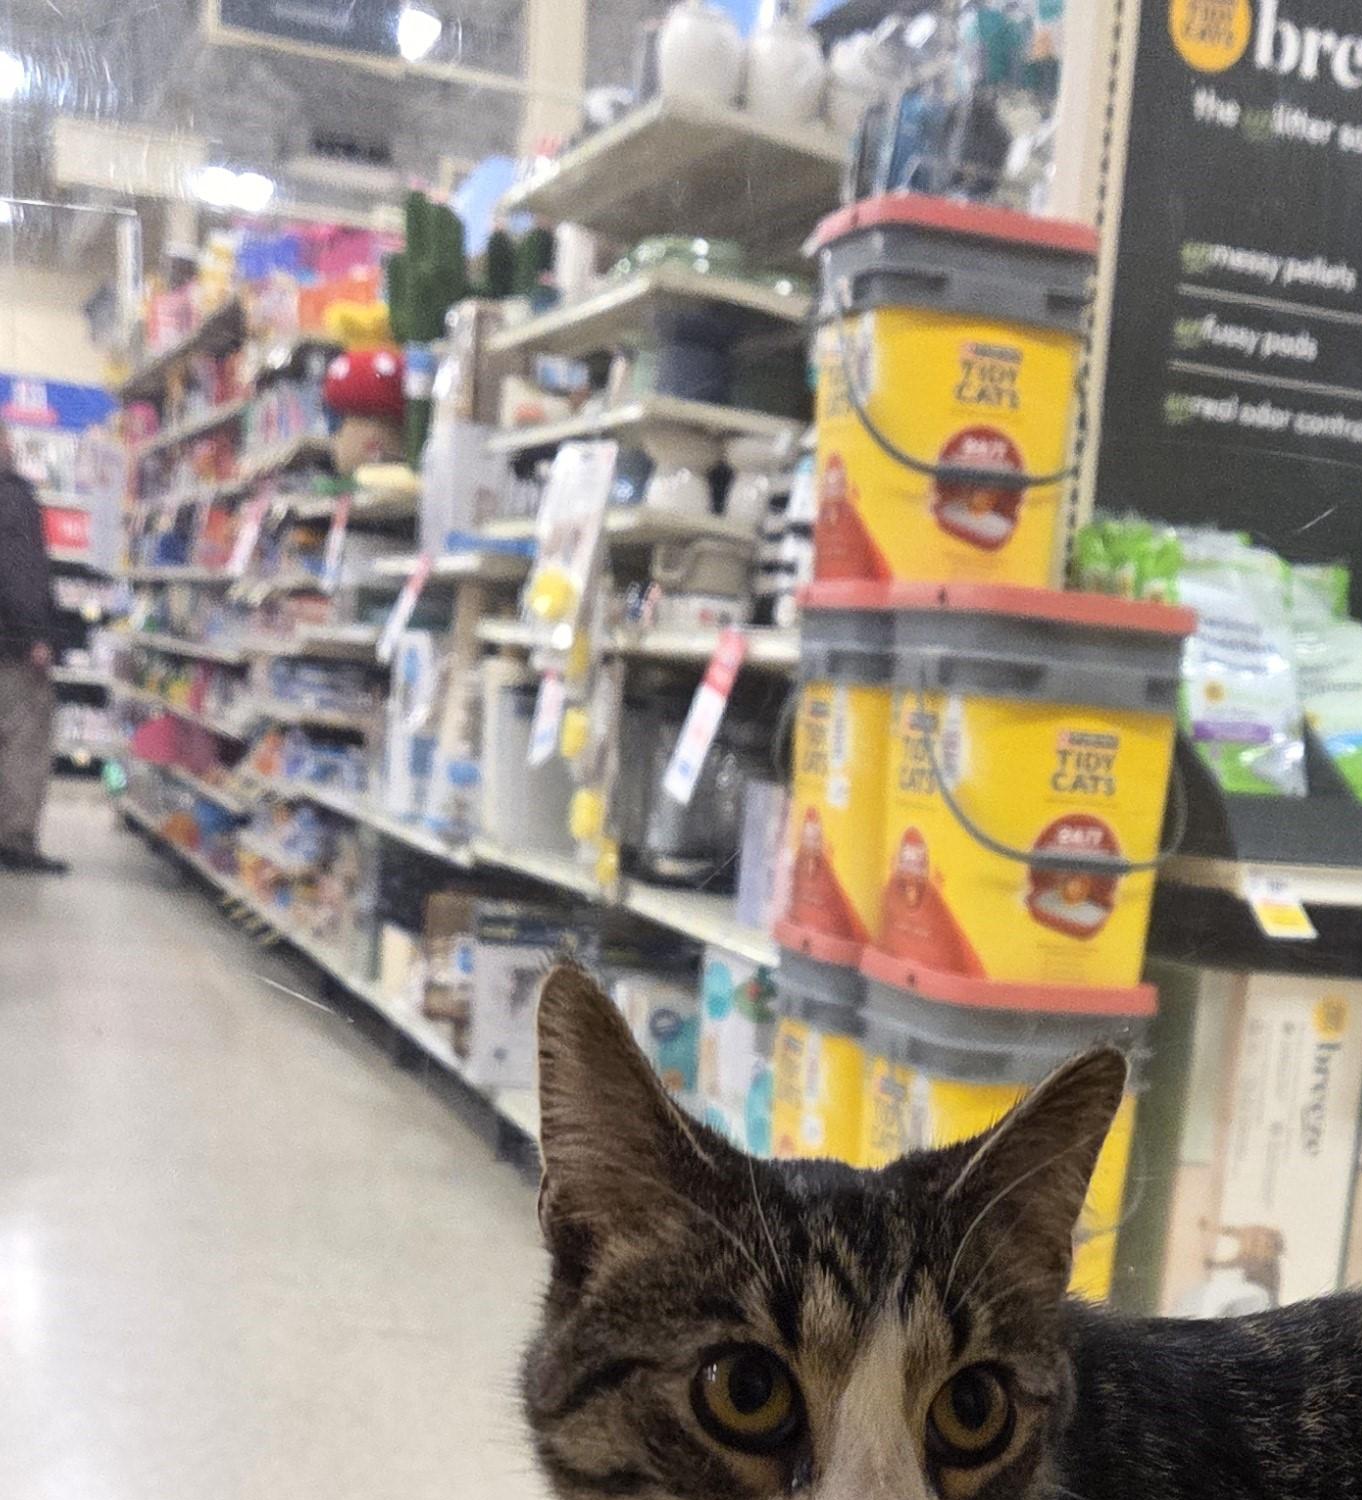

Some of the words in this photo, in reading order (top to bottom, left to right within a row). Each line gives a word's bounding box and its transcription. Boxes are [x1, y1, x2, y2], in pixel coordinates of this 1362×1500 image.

[1193, 86, 1240, 128] the
[1241, 102, 1336, 145] litter
[1057, 748, 1116, 772] TIDY
[1051, 772, 1116, 796] CATS
[1302, 1041, 1342, 1157] breeze
